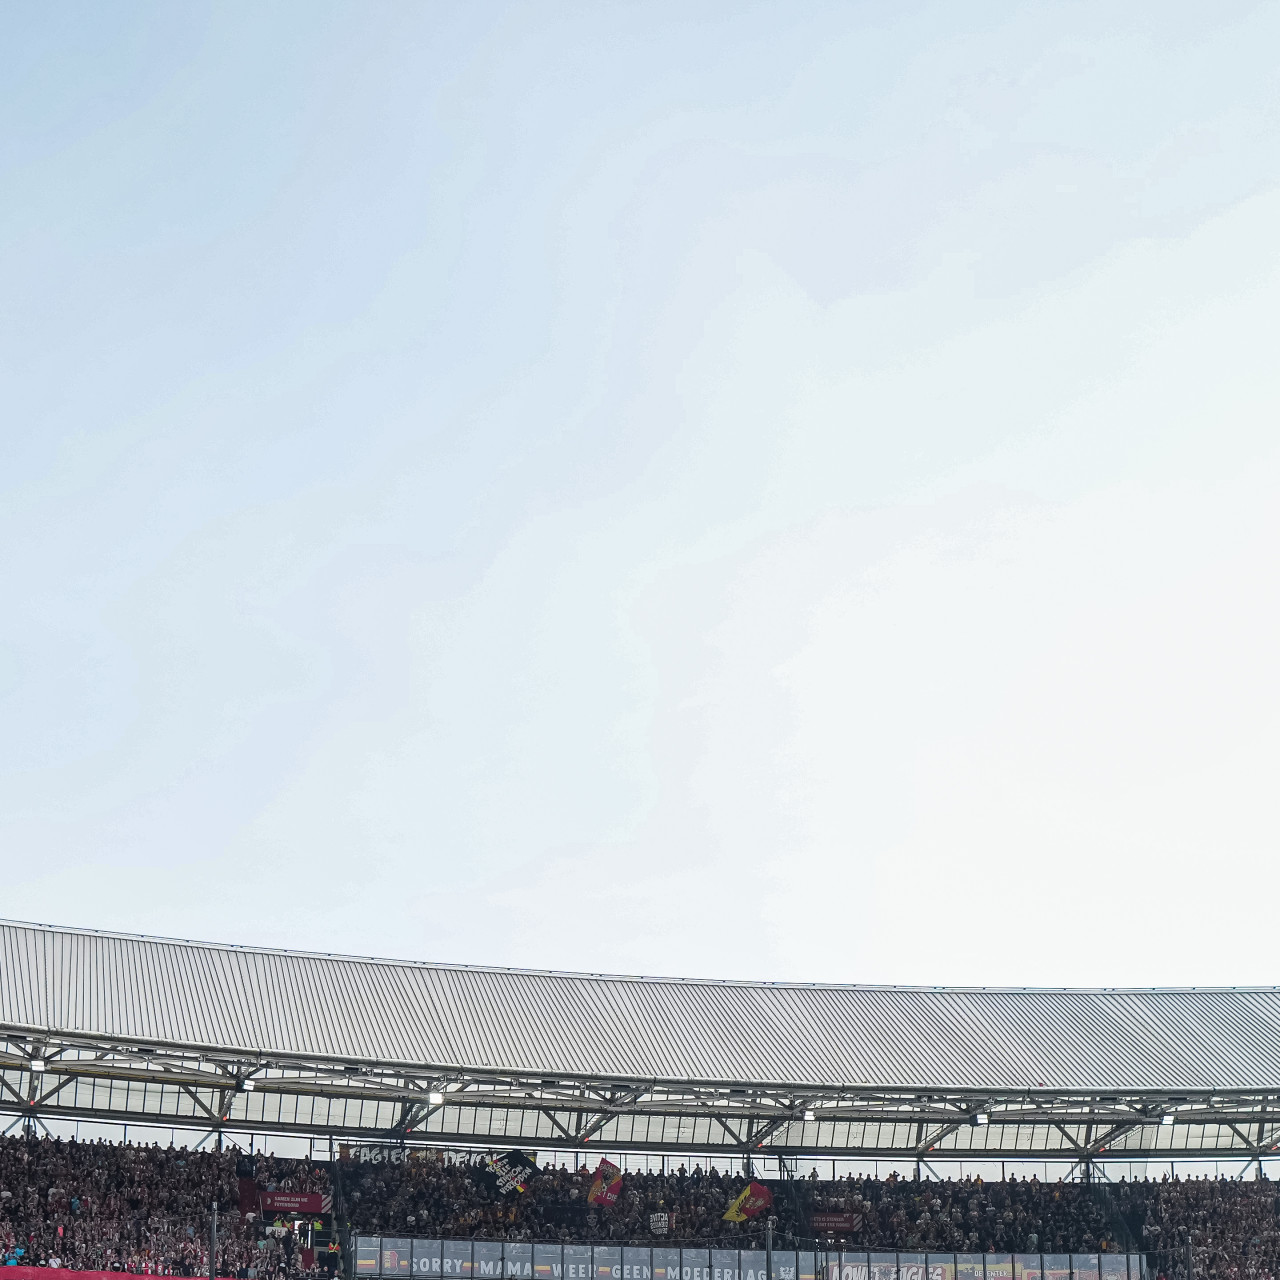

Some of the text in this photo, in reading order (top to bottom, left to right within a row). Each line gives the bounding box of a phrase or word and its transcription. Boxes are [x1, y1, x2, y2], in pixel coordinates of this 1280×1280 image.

[412, 1257, 464, 1273] SORRY
[480, 1260, 539, 1277] MAMA,
[552, 1263, 597, 1278] WEER
[611, 1264, 651, 1280] GEEN
